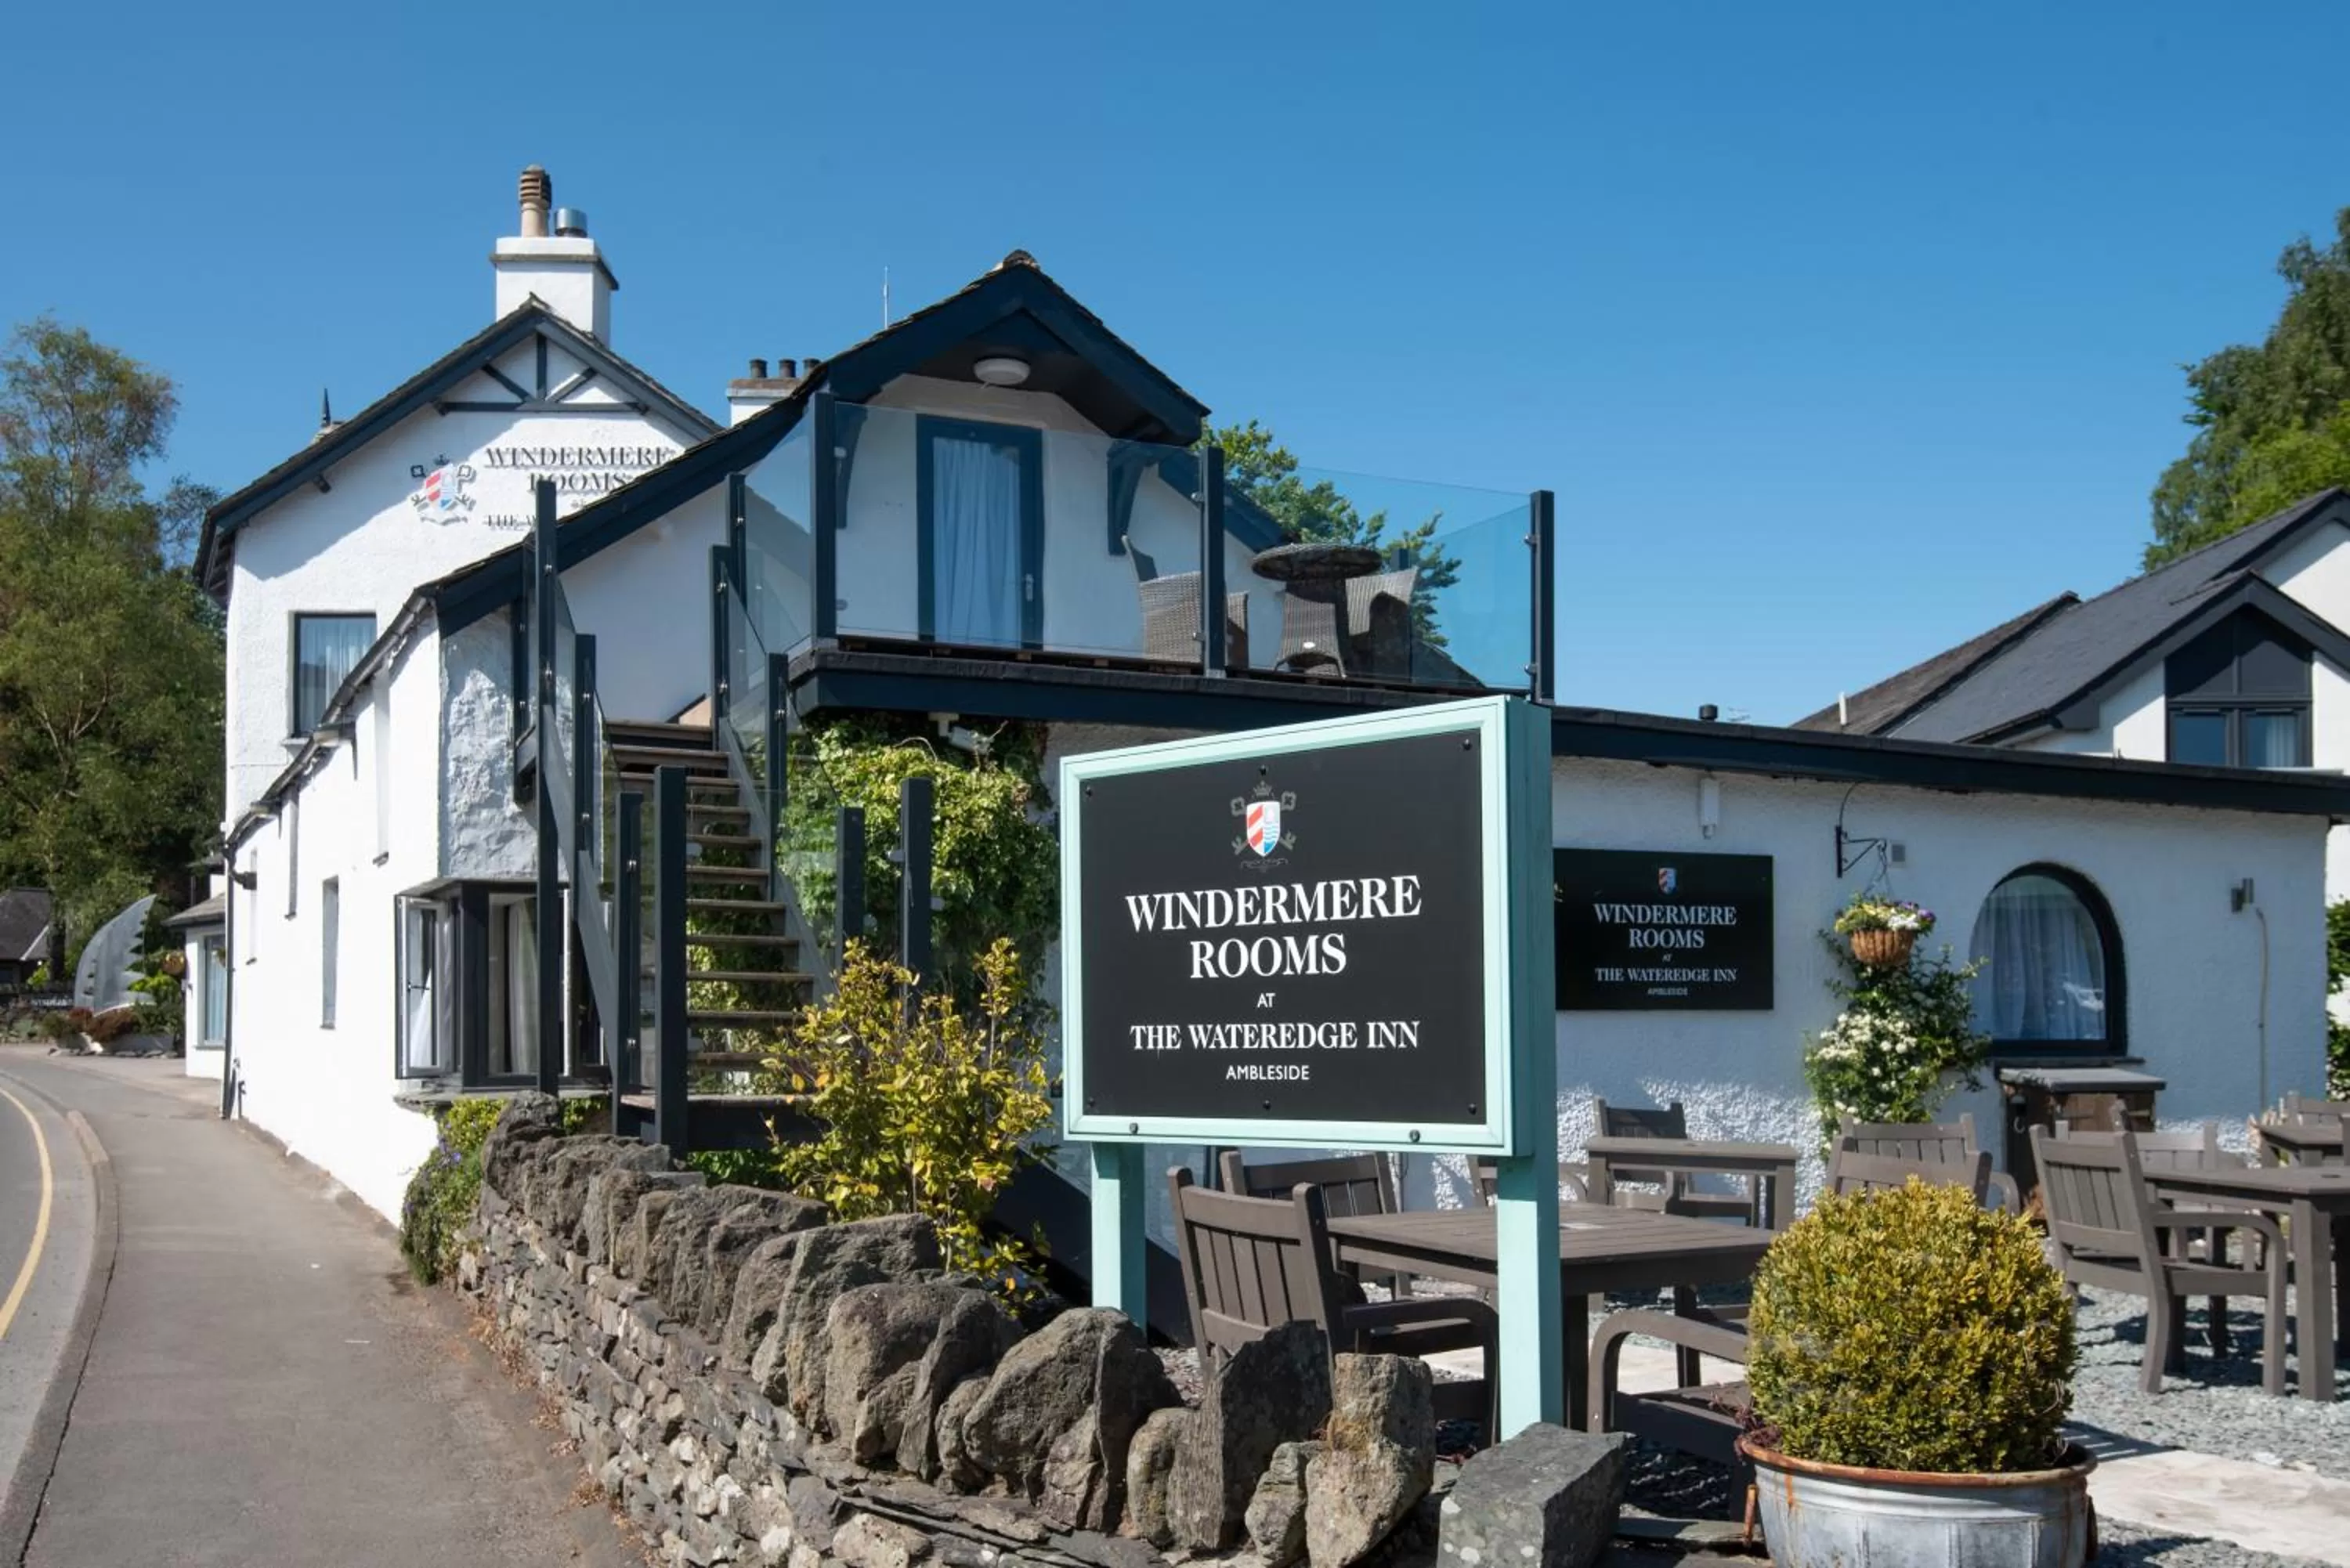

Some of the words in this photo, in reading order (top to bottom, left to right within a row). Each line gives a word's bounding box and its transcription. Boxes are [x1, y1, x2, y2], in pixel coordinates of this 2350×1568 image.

[486, 446, 674, 467] WINDERMERE
[1126, 875, 1422, 932] WINDERMERE
[1593, 904, 1737, 925] WINDERMERE
[1629, 928, 1705, 948] ROOMS
[1191, 934, 1347, 978] ROOMS
[1595, 968, 1623, 981] THE
[1628, 968, 1710, 982] WATEREDGE
[1714, 969, 1737, 982] INN
[1257, 993, 1276, 1008] AT
[1130, 1025, 1181, 1050] THE
[1188, 1022, 1358, 1050] WATEREDGE
[1367, 1021, 1420, 1049] INN
[1226, 1065, 1310, 1081] AMBLESIDE
